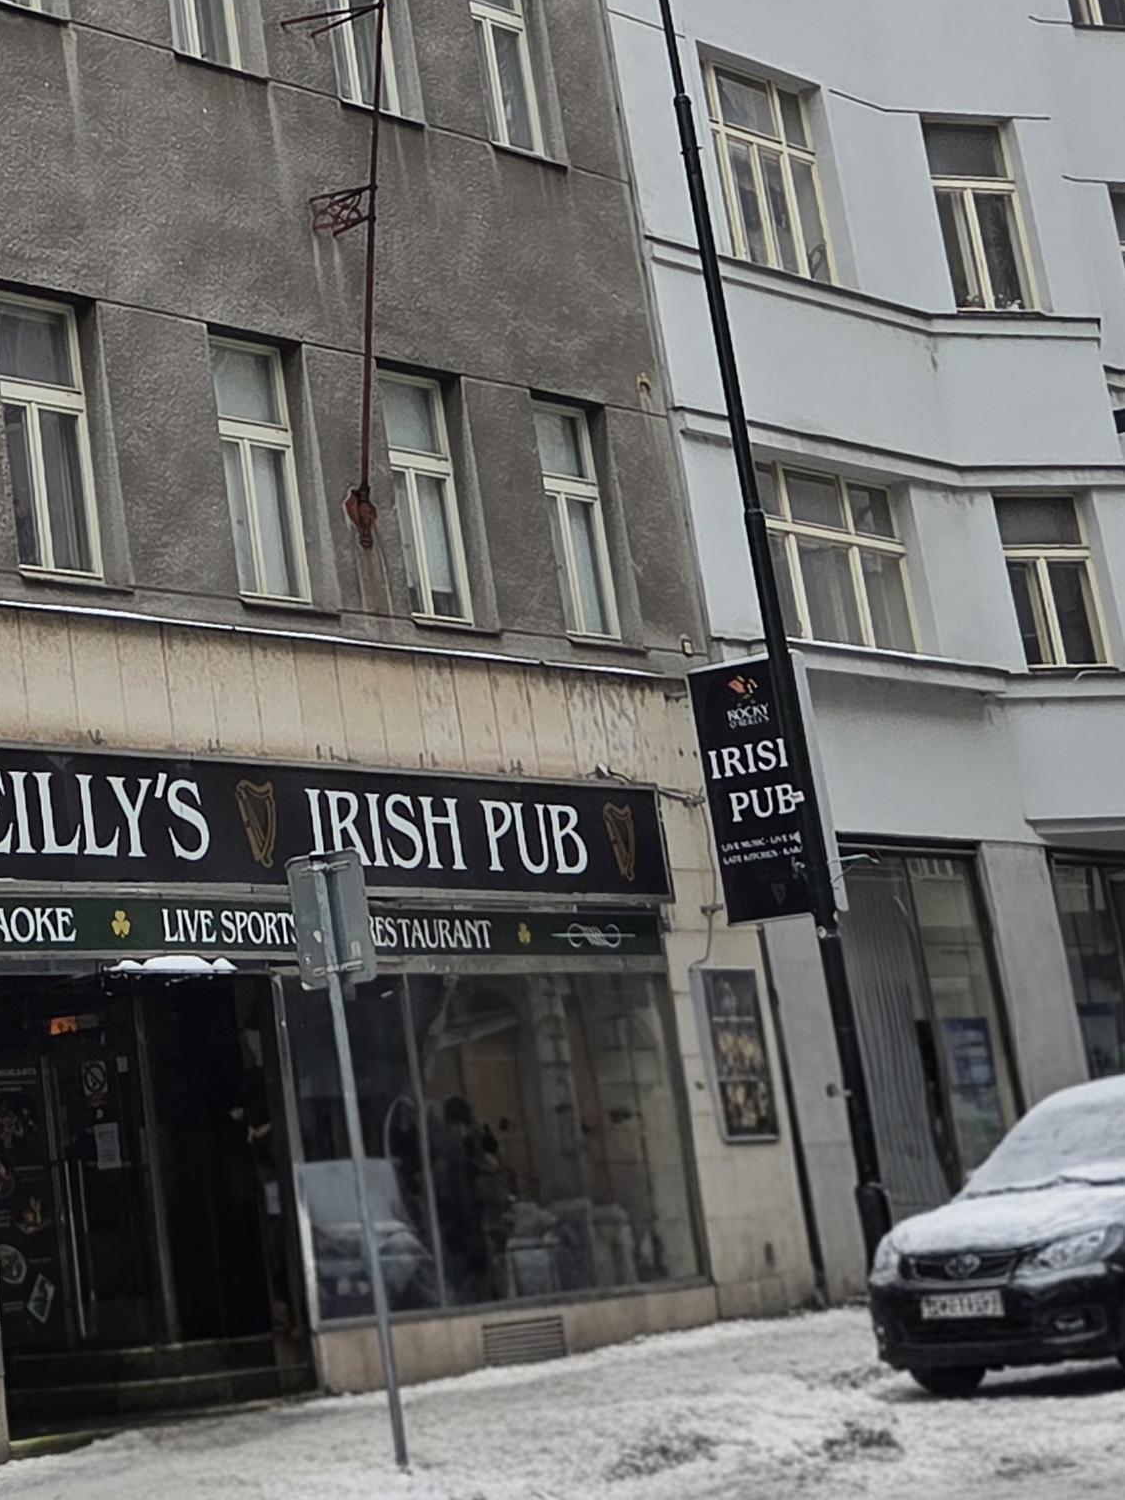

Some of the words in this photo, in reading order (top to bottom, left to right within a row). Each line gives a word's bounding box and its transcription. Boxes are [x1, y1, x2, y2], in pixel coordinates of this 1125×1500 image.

[728, 783, 797, 823] PUB
[304, 788, 468, 871] IRISH
[479, 799, 588, 875] PUB
[161, 908, 217, 943] LIVE
